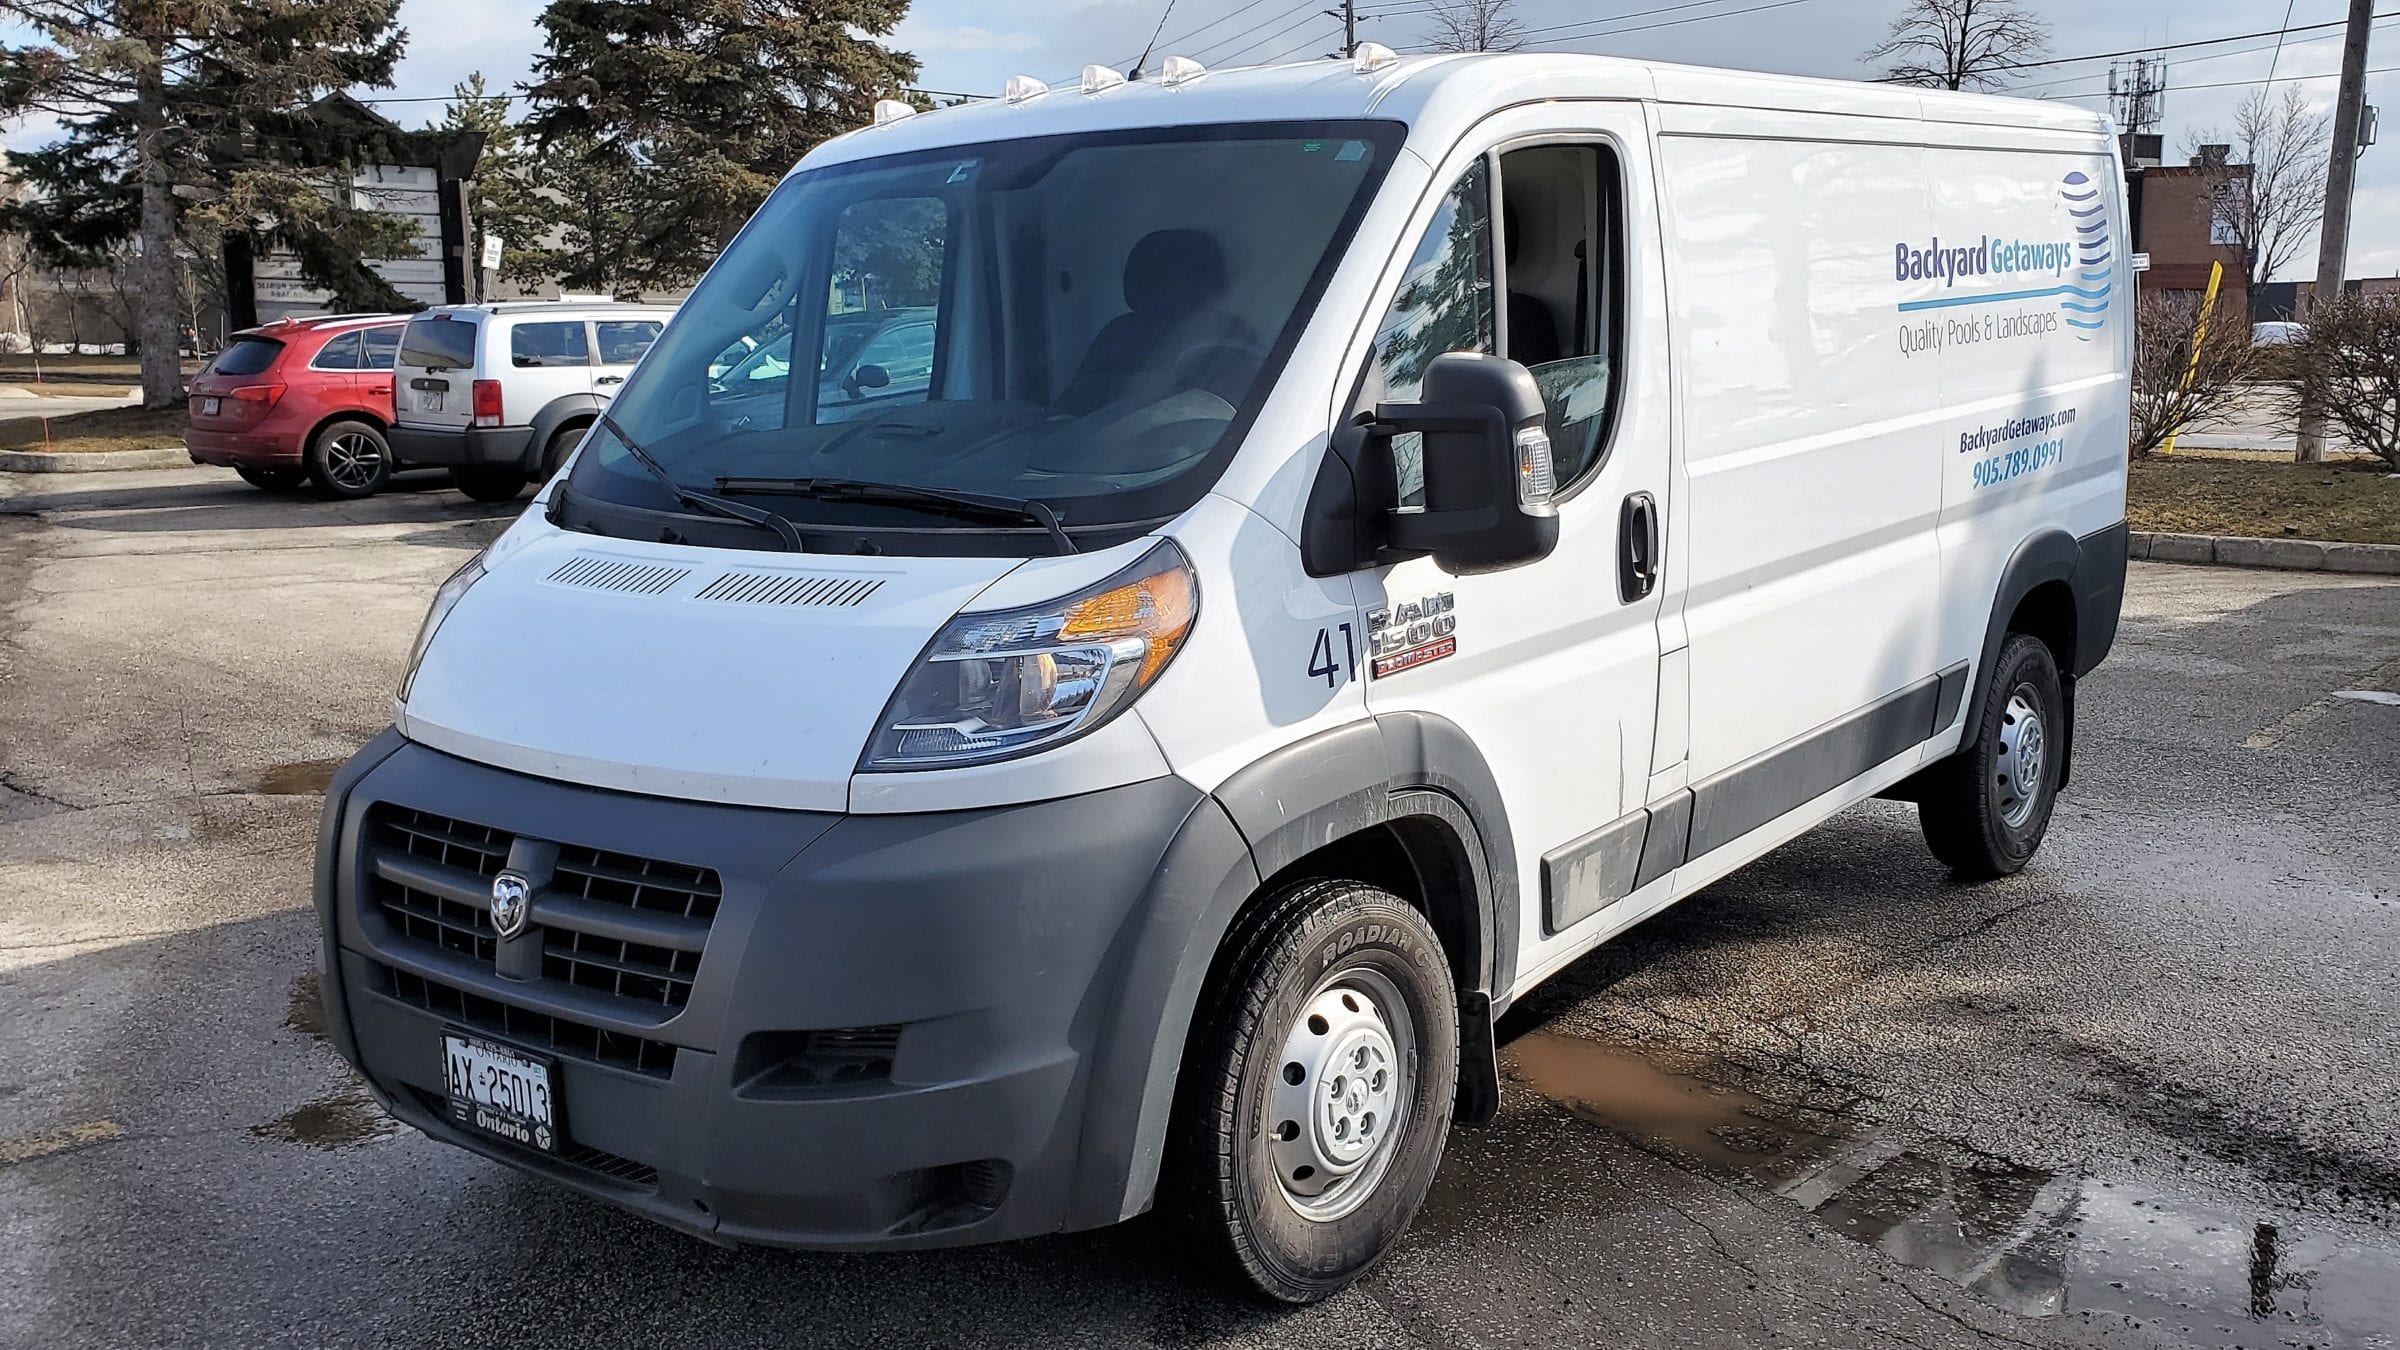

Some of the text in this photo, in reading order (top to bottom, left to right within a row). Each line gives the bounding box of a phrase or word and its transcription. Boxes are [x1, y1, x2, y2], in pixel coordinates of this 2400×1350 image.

[1895, 235, 2071, 288] Backyard Getaways
[1899, 308, 2057, 358] Quality Pools & Landscapes
[1960, 408, 2076, 453] BackyardGetaways.com
[1973, 438, 2064, 489] 905.789.0991
[1366, 592, 1455, 633] RAM
[1308, 623, 1356, 688] 41
[1369, 615, 1456, 656] 1500
[1376, 642, 1454, 674] PROMASTER
[1322, 924, 1414, 968] ROADIAN
[476, 1110, 530, 1142] Ontario
